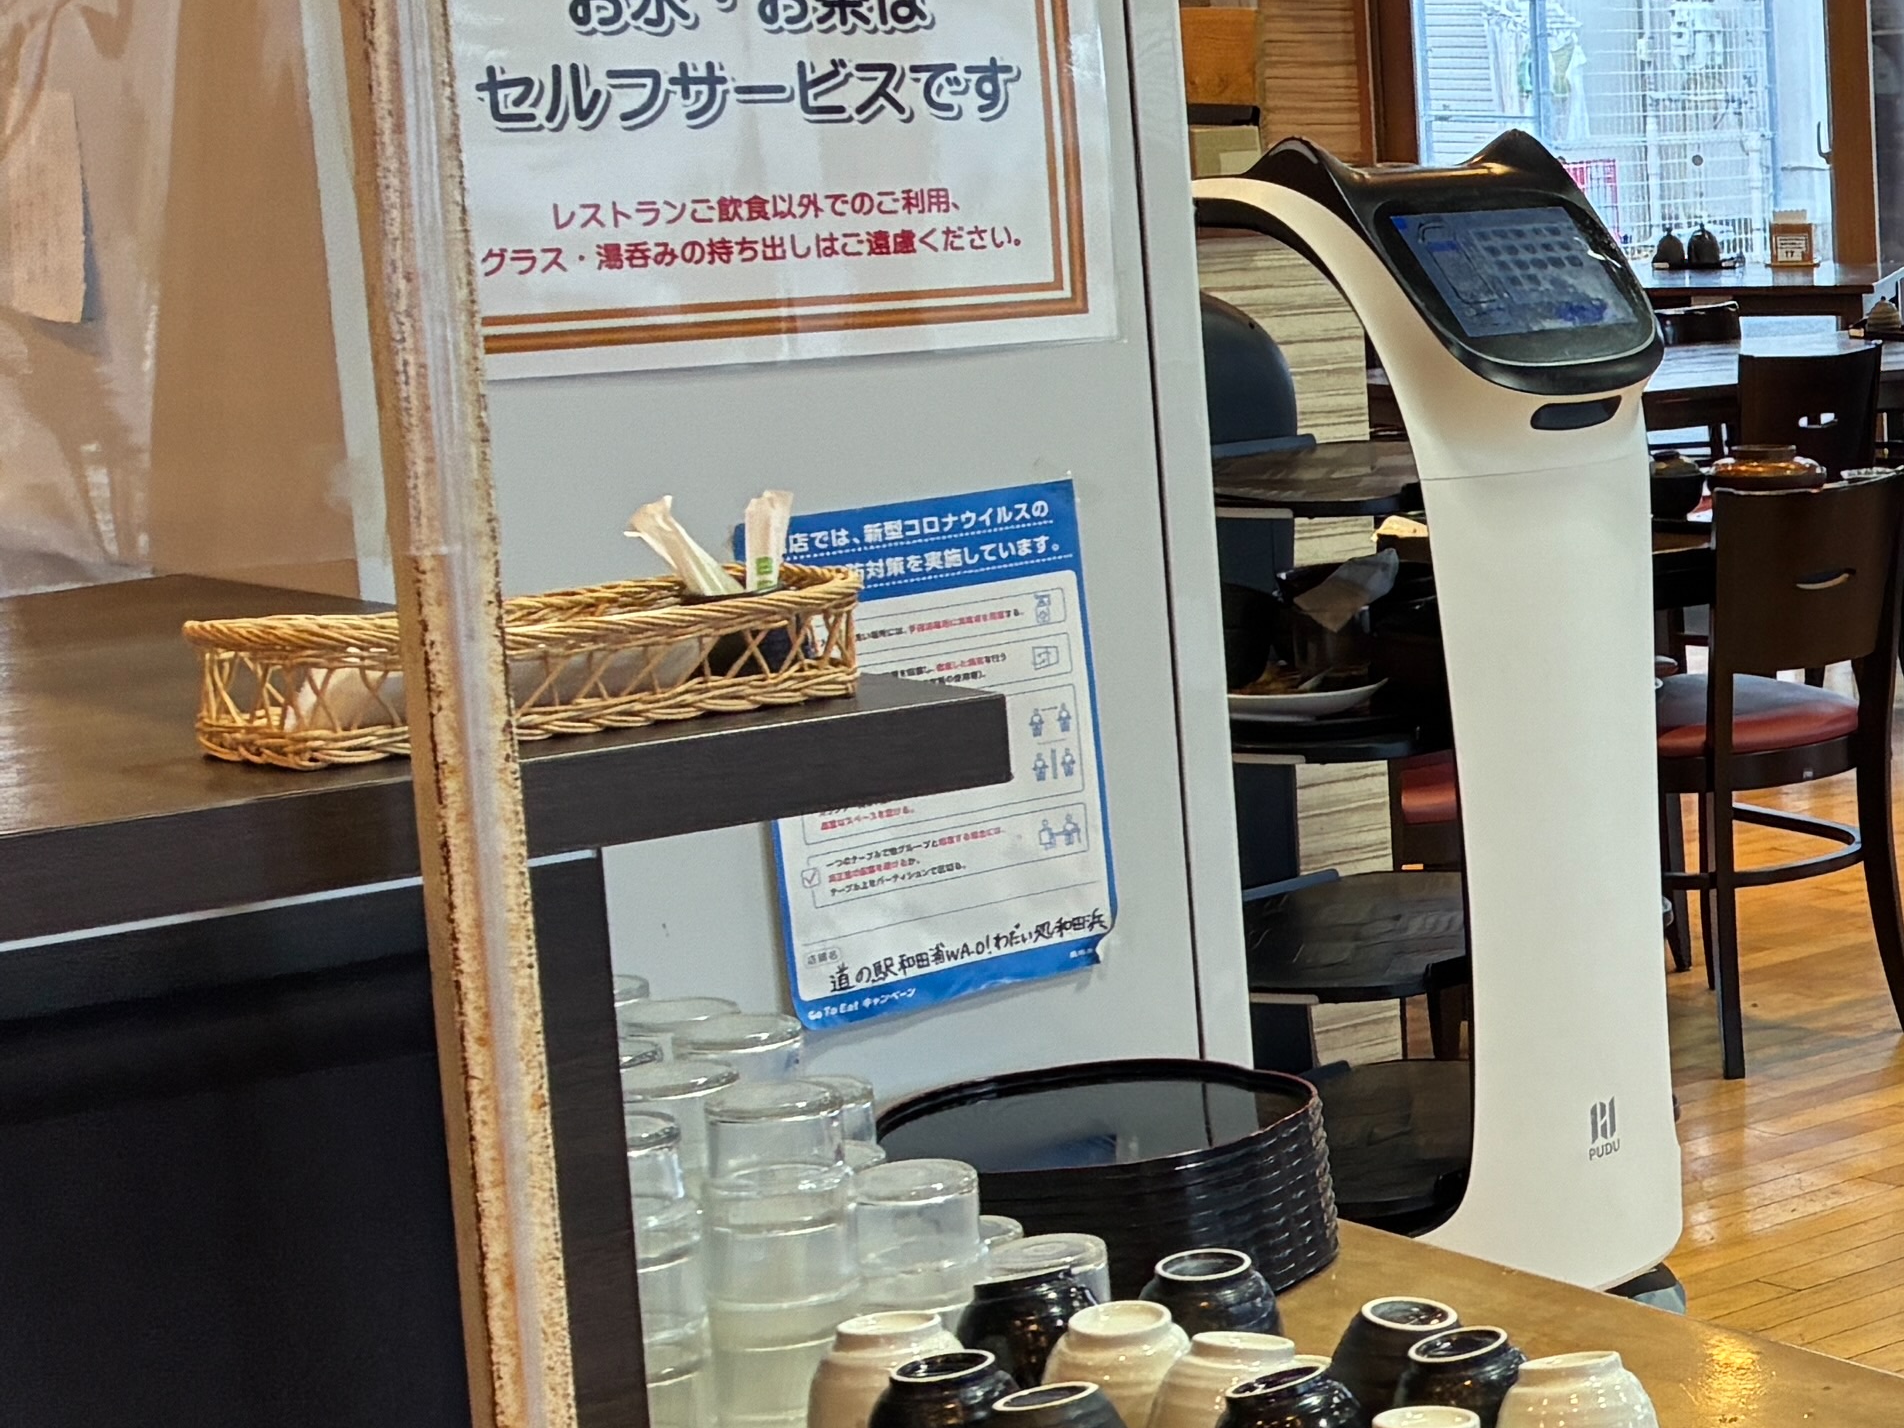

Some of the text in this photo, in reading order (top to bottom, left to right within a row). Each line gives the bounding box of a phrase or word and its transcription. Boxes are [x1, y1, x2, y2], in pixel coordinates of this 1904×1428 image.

[475, 56, 1021, 133] セルフサービスです
[552, 185, 961, 232] レストランご飲食以外でのご利用、
[480, 226, 1027, 278] グラス・湯呑みの持ち出しはご遠慮ください。
[861, 986, 917, 1010] キャンペーン
[1588, 1138, 1621, 1161] PUDU
